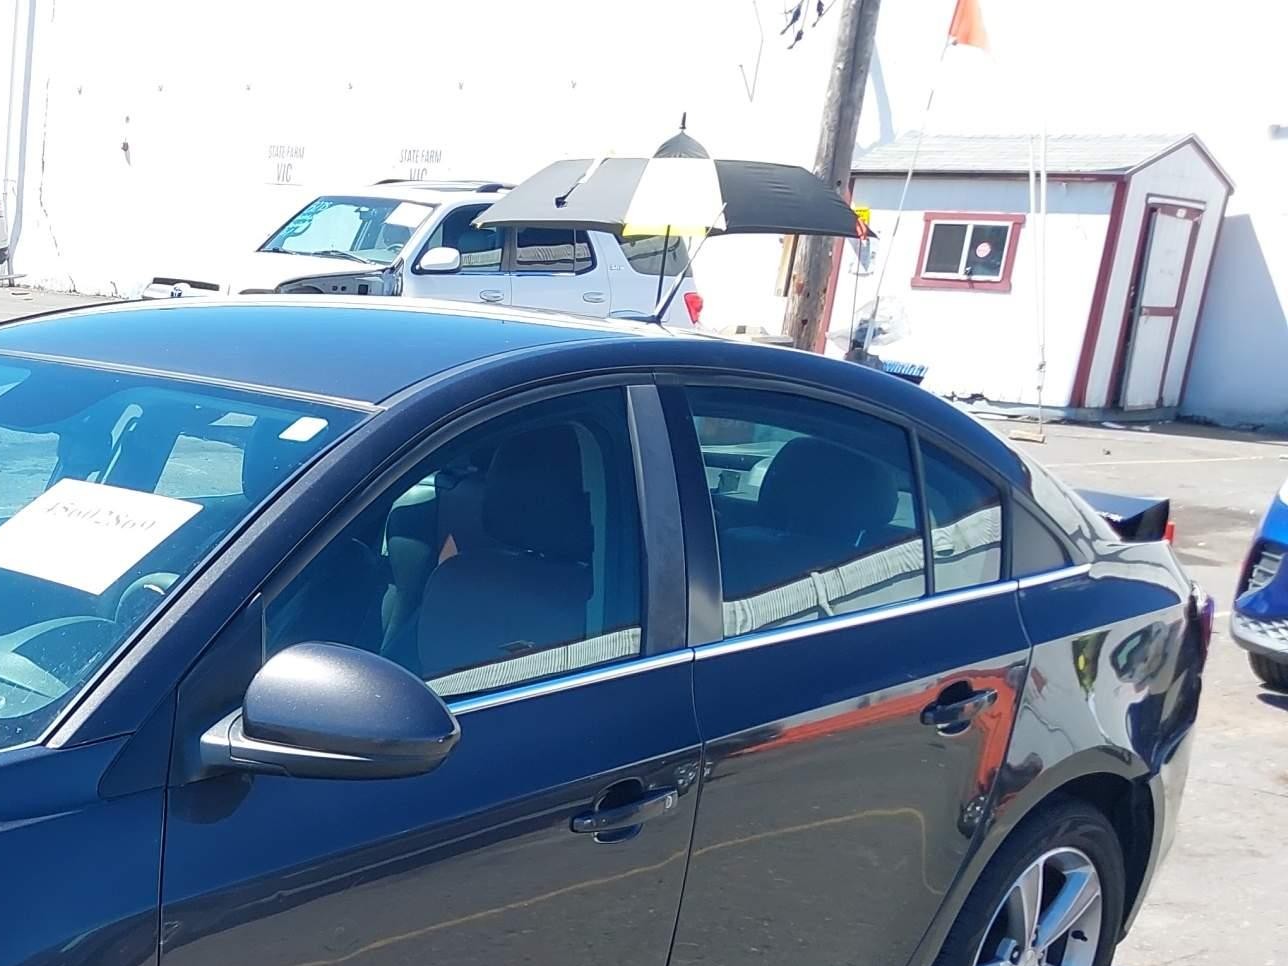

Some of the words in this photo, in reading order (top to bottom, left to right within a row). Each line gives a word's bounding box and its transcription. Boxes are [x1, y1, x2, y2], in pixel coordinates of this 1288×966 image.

[268, 145, 286, 159] STATE
[287, 145, 305, 160] FARM
[400, 149, 420, 164] STATE
[421, 149, 442, 164] FARM
[276, 163, 293, 183] VIC
